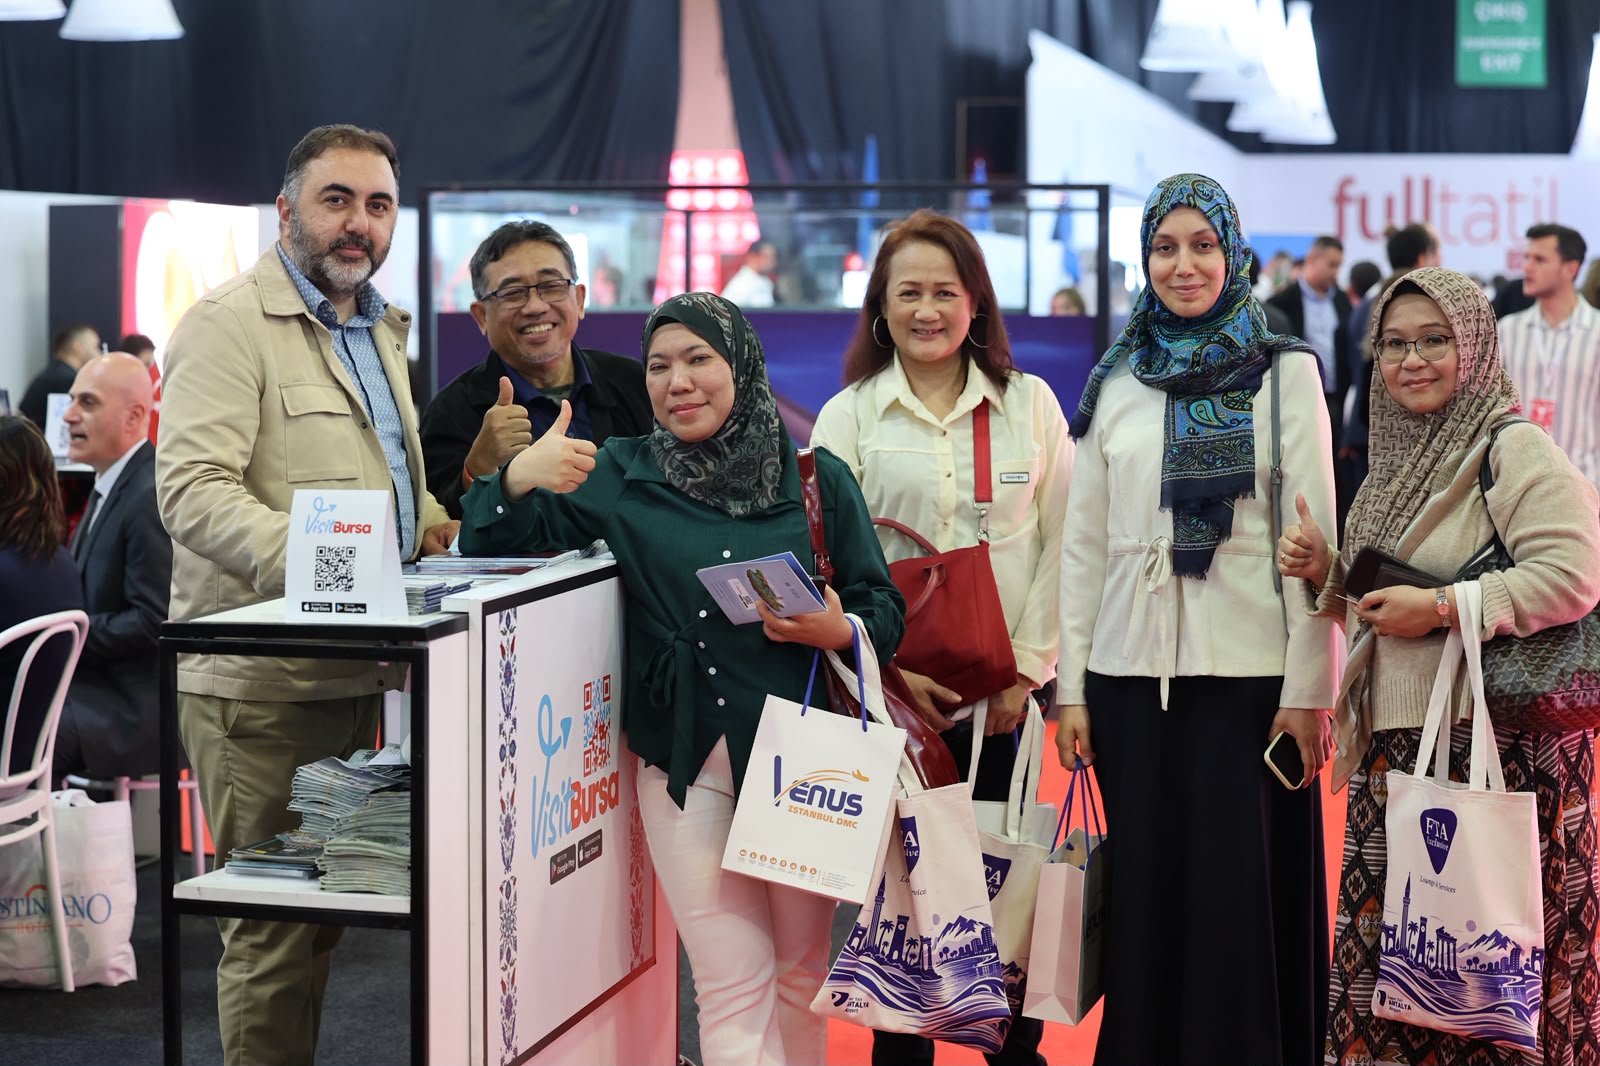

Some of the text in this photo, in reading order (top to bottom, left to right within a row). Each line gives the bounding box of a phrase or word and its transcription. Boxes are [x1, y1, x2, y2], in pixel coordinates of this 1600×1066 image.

[787, 804, 858, 830] ISTANBUL DMC
[1425, 816, 1449, 841] FTA
[1426, 836, 1449, 852] Exclusive
[1389, 1000, 1412, 1011] ANTALYA
